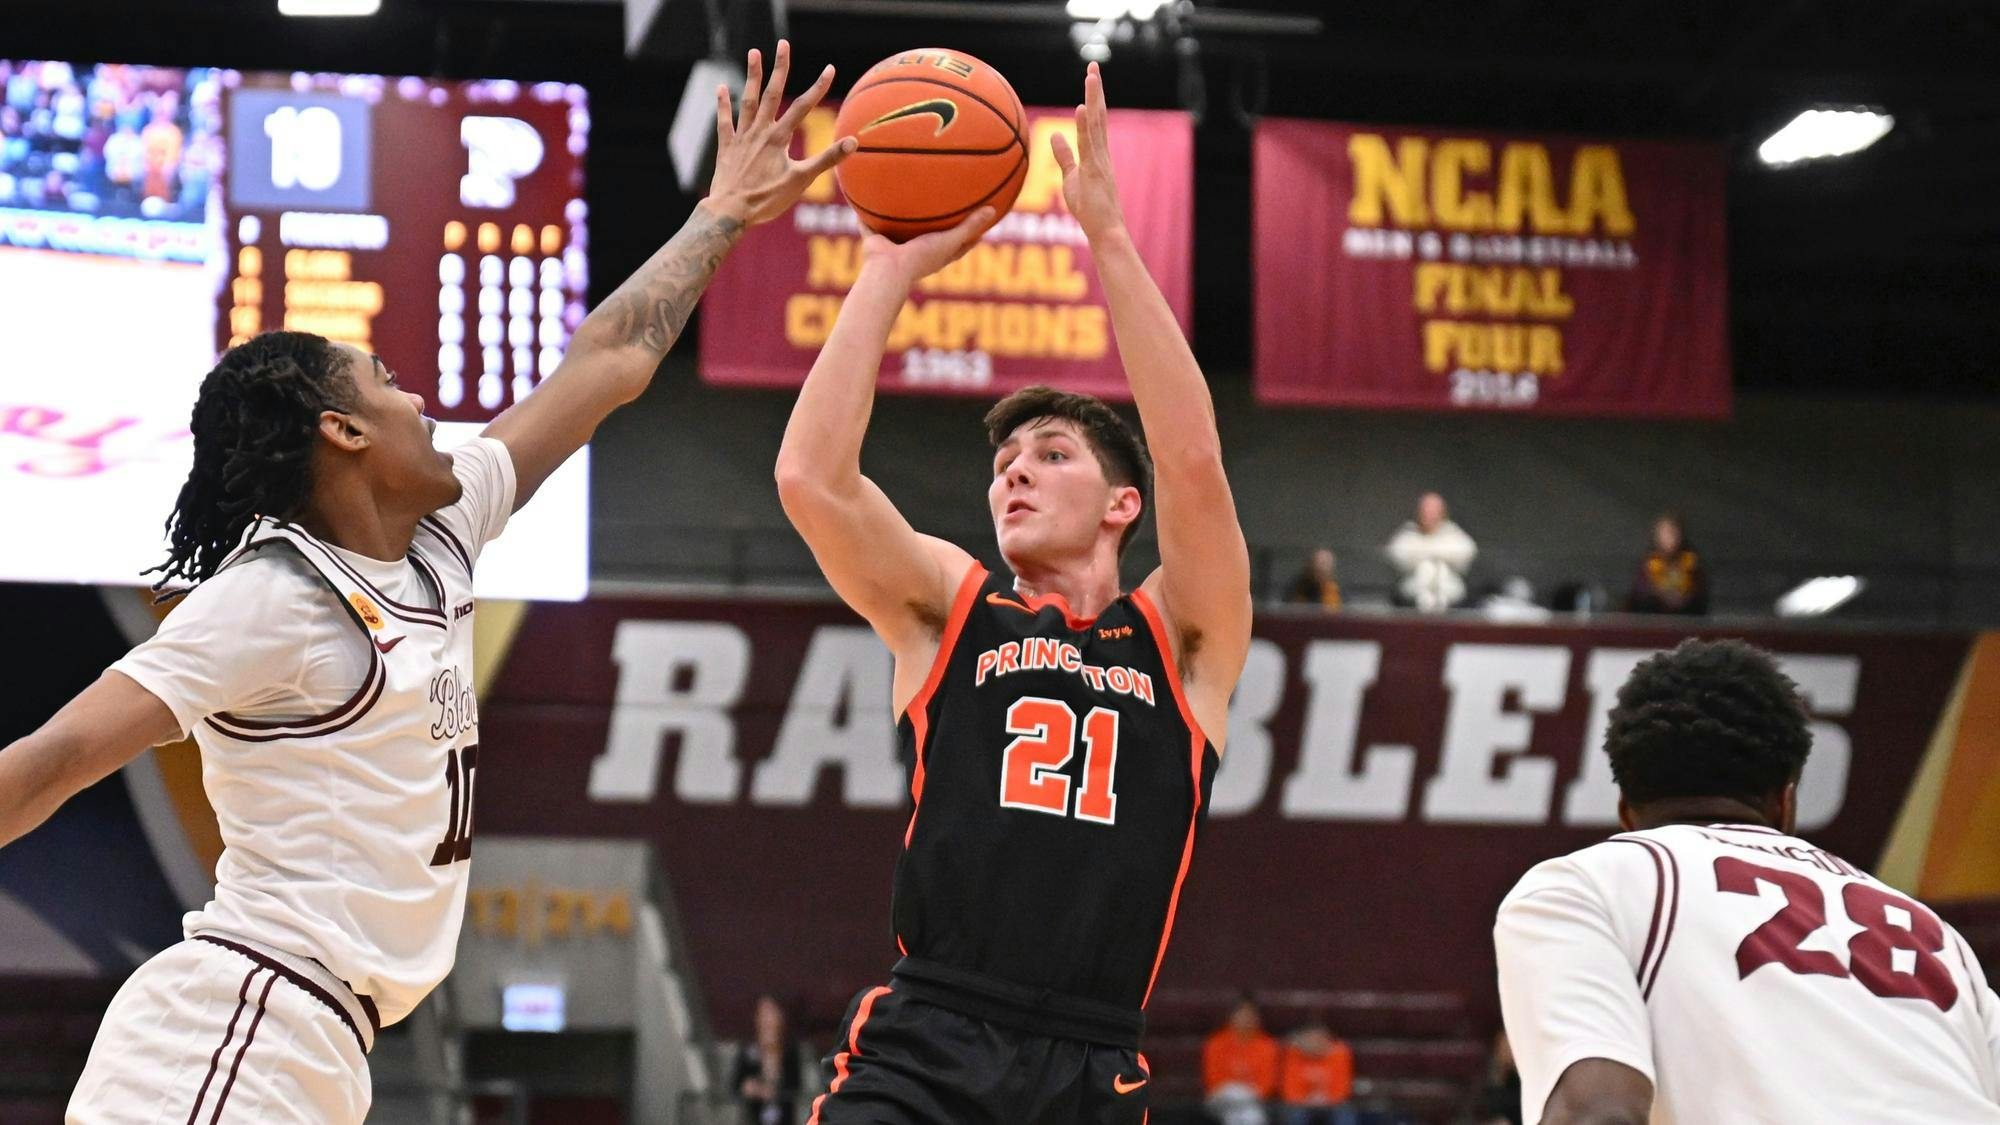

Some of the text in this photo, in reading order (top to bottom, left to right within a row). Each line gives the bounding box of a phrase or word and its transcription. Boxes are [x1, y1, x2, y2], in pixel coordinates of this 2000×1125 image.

[874, 54, 974, 78] ELIT
[1348, 133, 1636, 234] NCAA
[808, 234, 1088, 300] NONAL
[1415, 262, 1573, 319] FINAL
[785, 293, 1108, 360] CMPIONS
[1424, 320, 1564, 377] FOUR
[976, 637, 1155, 706] PRINCTON
[587, 619, 1859, 832] RABLES
[1000, 695, 1119, 825] 21
[430, 744, 478, 867] 10
[1714, 856, 1958, 1013] 28
